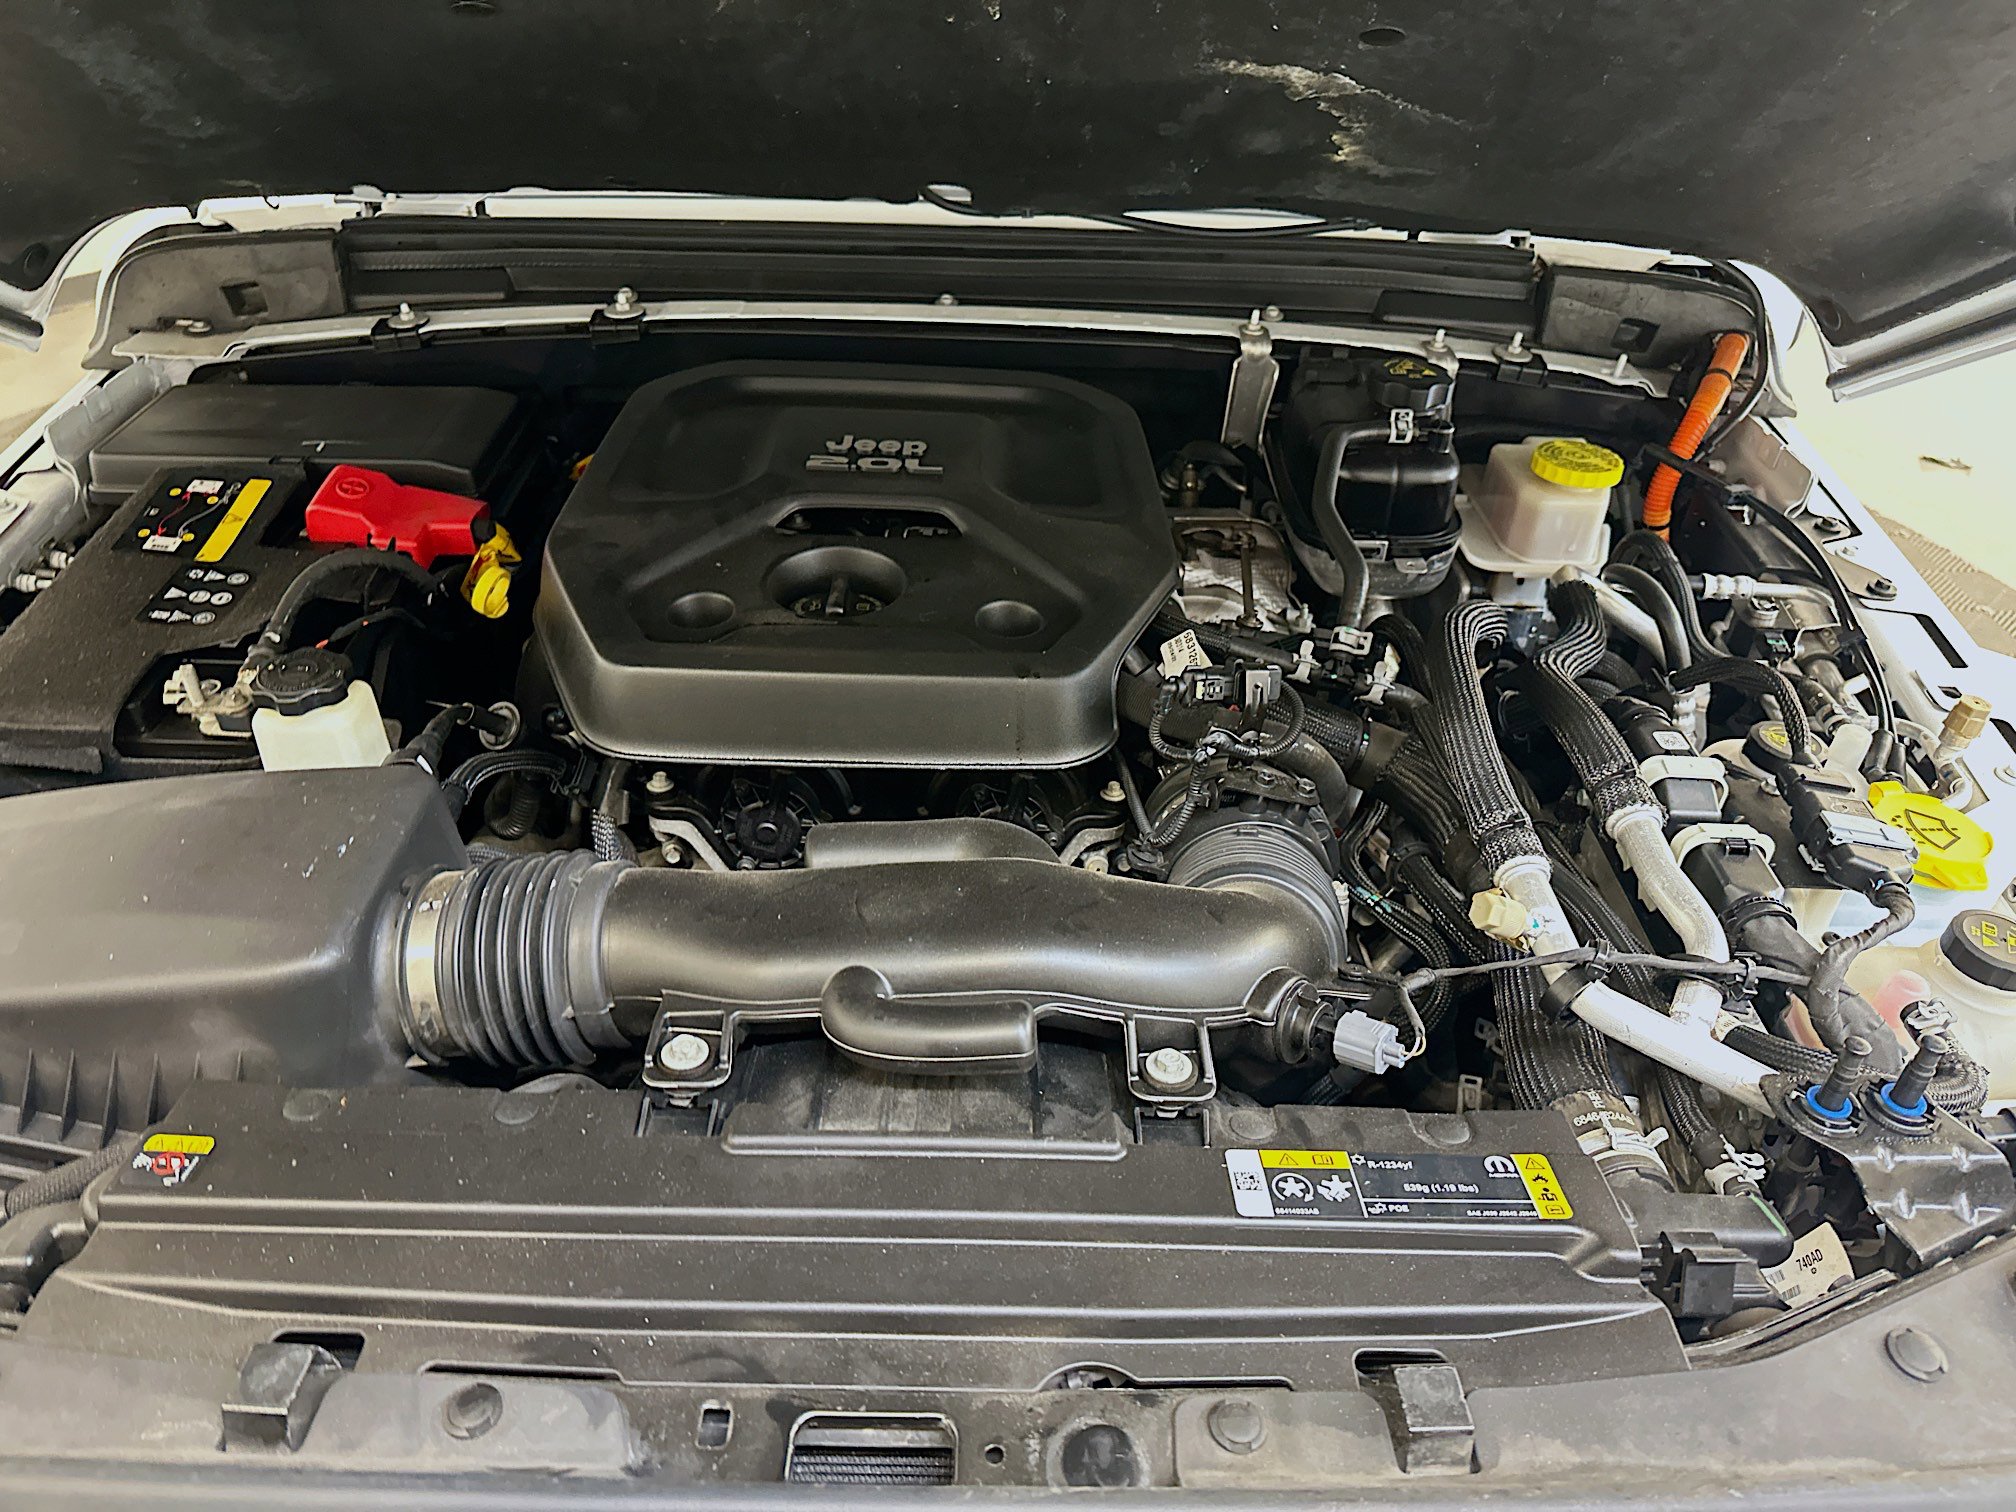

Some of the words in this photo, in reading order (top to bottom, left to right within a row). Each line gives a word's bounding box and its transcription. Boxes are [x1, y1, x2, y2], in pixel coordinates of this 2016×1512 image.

[825, 434, 928, 456] Jeep
[805, 454, 944, 474] 2.0L
[1795, 1248, 1824, 1271] 740AD
